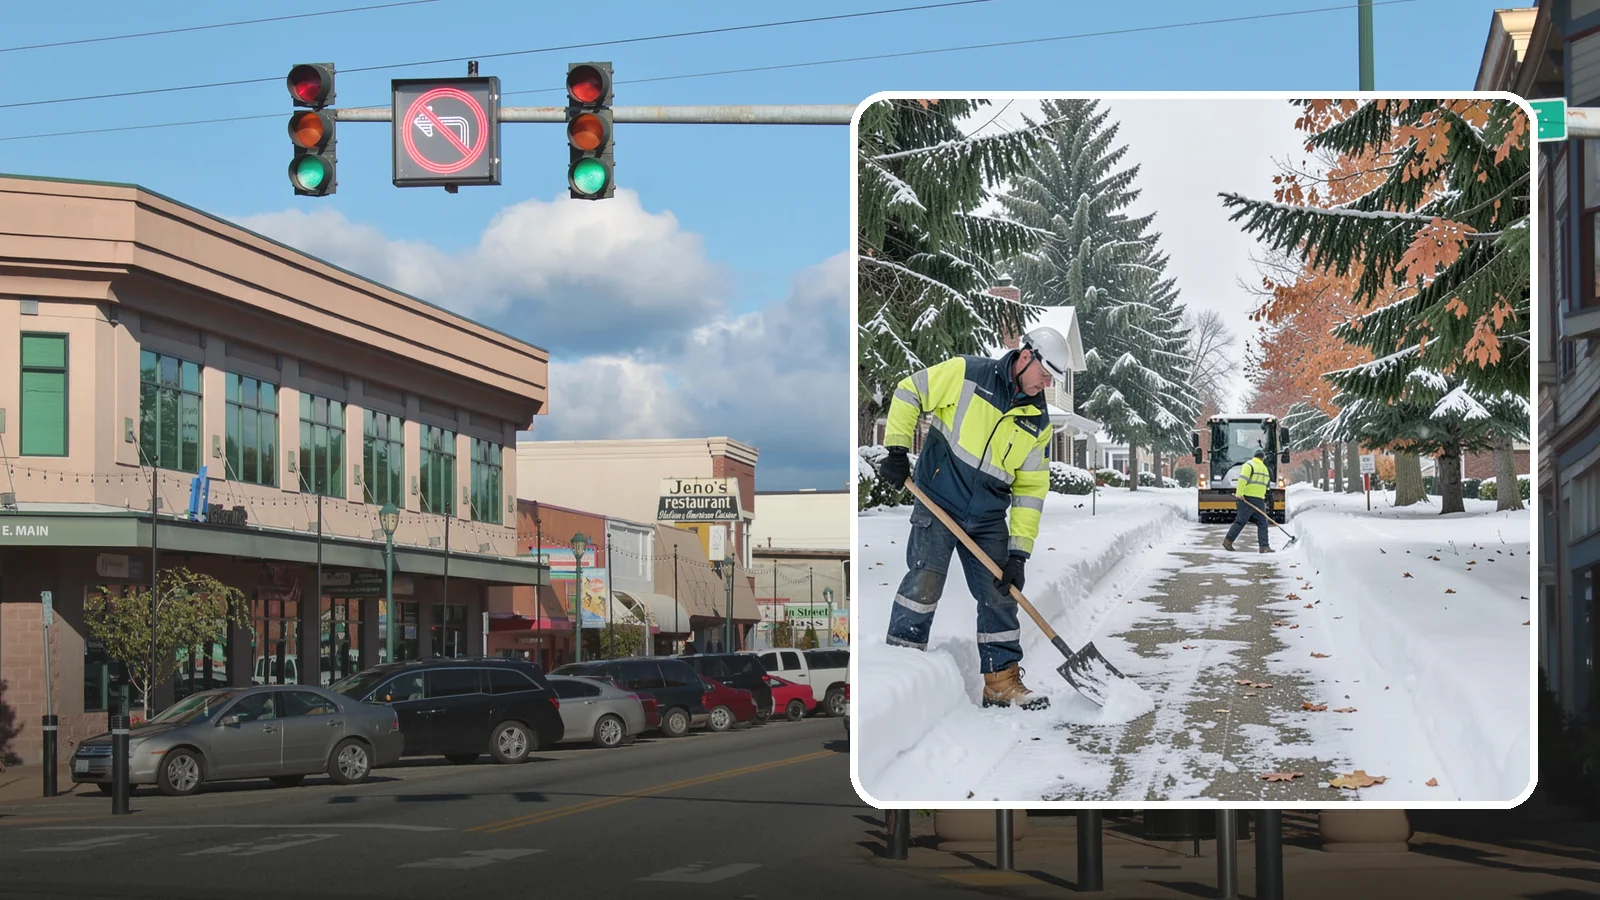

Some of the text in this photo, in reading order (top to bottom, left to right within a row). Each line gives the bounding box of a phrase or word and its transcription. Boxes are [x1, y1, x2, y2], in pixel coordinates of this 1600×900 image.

[669, 480, 728, 494] Jeno's
[665, 496, 731, 509] restaurant
[658, 510, 681, 519] Italian
[686, 509, 714, 519] American
[714, 509, 738, 519] Cuisine
[2, 525, 49, 536] E. MAIN
[797, 607, 829, 617] Street
[790, 619, 824, 627] lass
